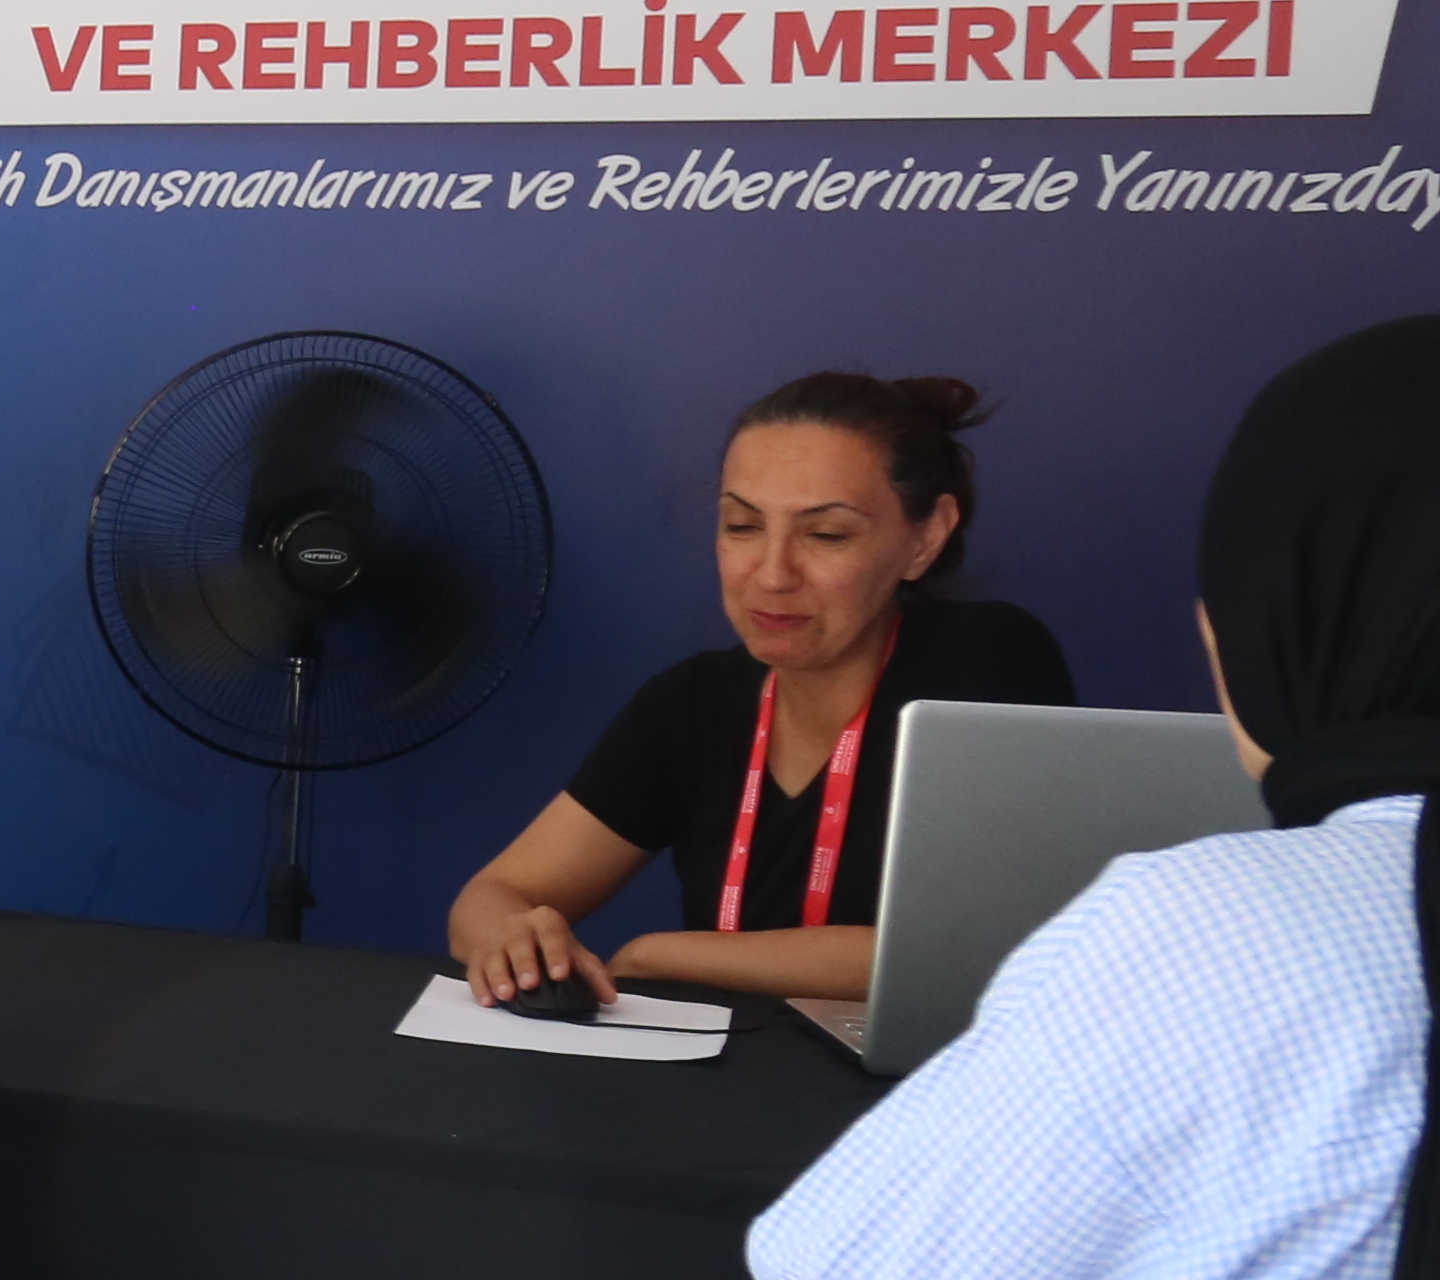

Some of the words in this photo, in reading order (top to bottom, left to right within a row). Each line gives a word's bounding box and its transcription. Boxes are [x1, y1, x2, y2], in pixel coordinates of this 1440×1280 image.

[30, 23, 155, 93] VE
[34, 151, 493, 214] Danışmanlarımız
[506, 167, 574, 212] ve
[588, 146, 1079, 213] Rehberlerimizle
